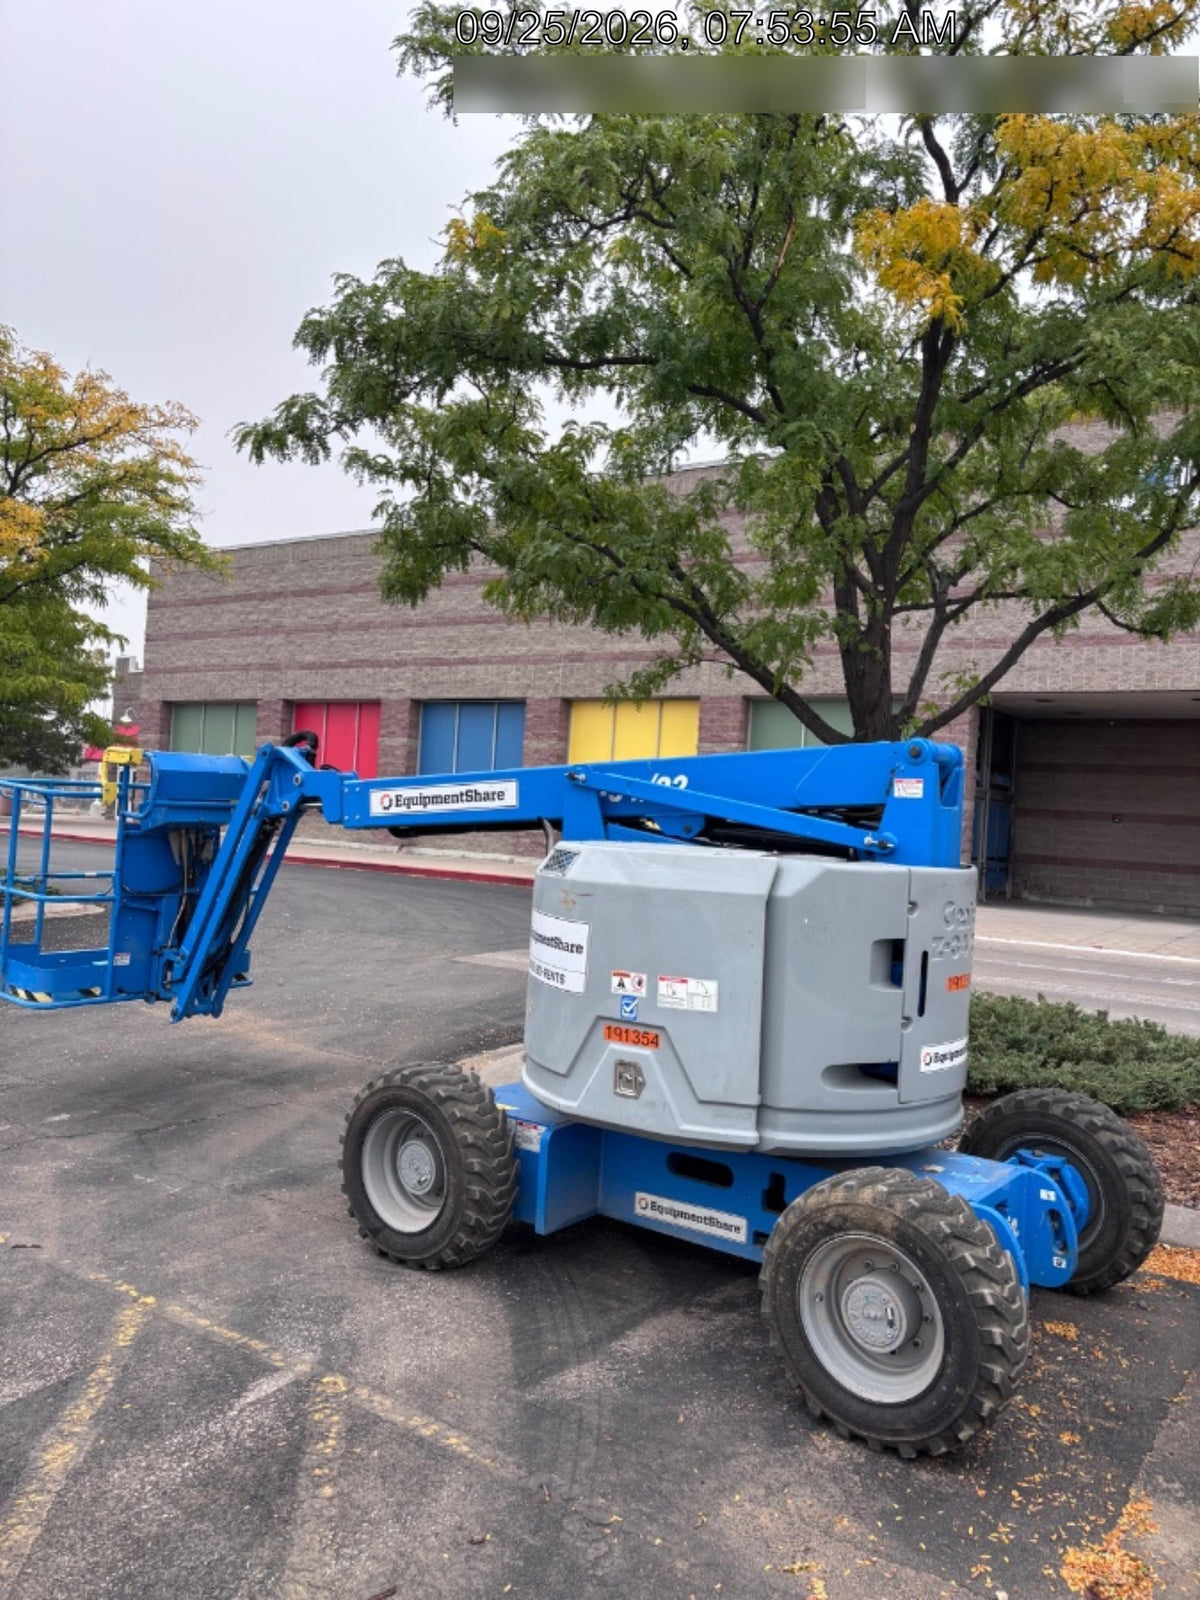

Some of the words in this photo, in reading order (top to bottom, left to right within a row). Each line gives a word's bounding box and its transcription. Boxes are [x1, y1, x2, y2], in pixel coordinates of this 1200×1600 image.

[394, 788, 505, 810] EquipmentShare
[605, 1025, 660, 1048] 191354
[650, 1200, 742, 1234] EquipmentShare
